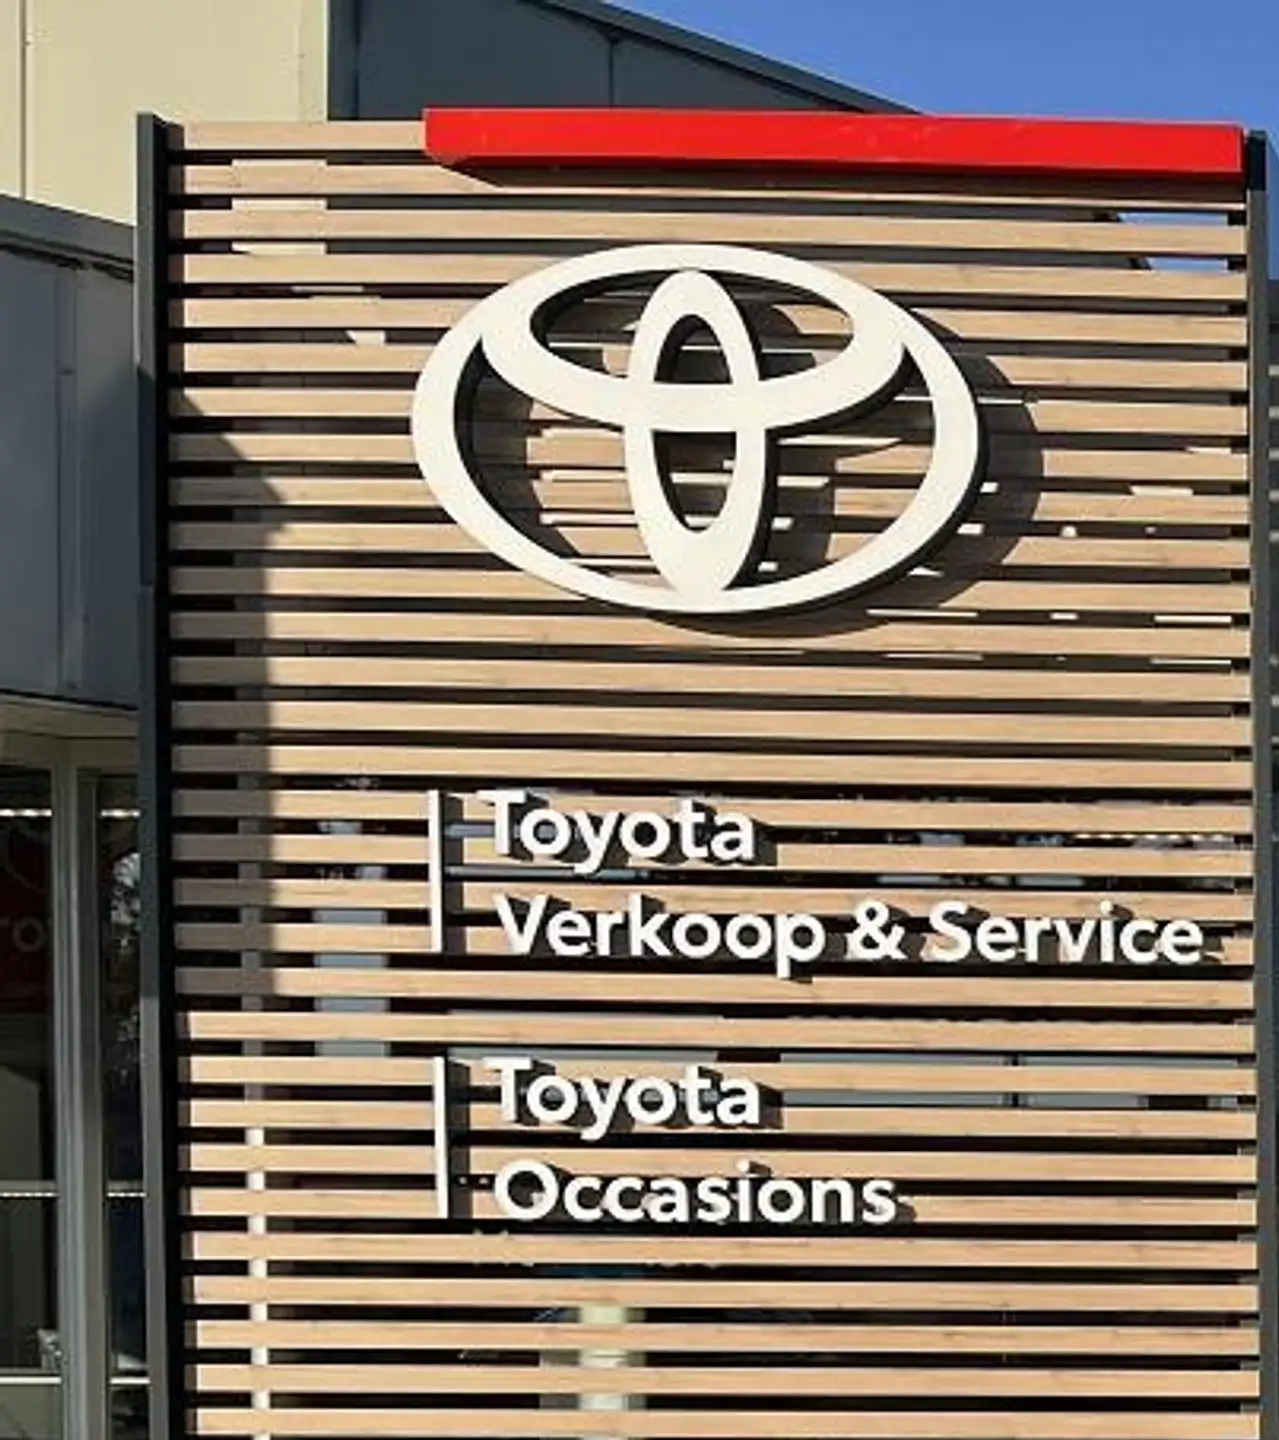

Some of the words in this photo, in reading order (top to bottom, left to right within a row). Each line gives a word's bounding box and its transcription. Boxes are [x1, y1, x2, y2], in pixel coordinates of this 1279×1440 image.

[477, 789, 756, 874] Toyota
[494, 893, 826, 979] Verkoop
[847, 901, 906, 962] &
[927, 900, 1203, 965] Service
[483, 1056, 763, 1139] Toyota
[494, 1158, 897, 1224] Occasions
